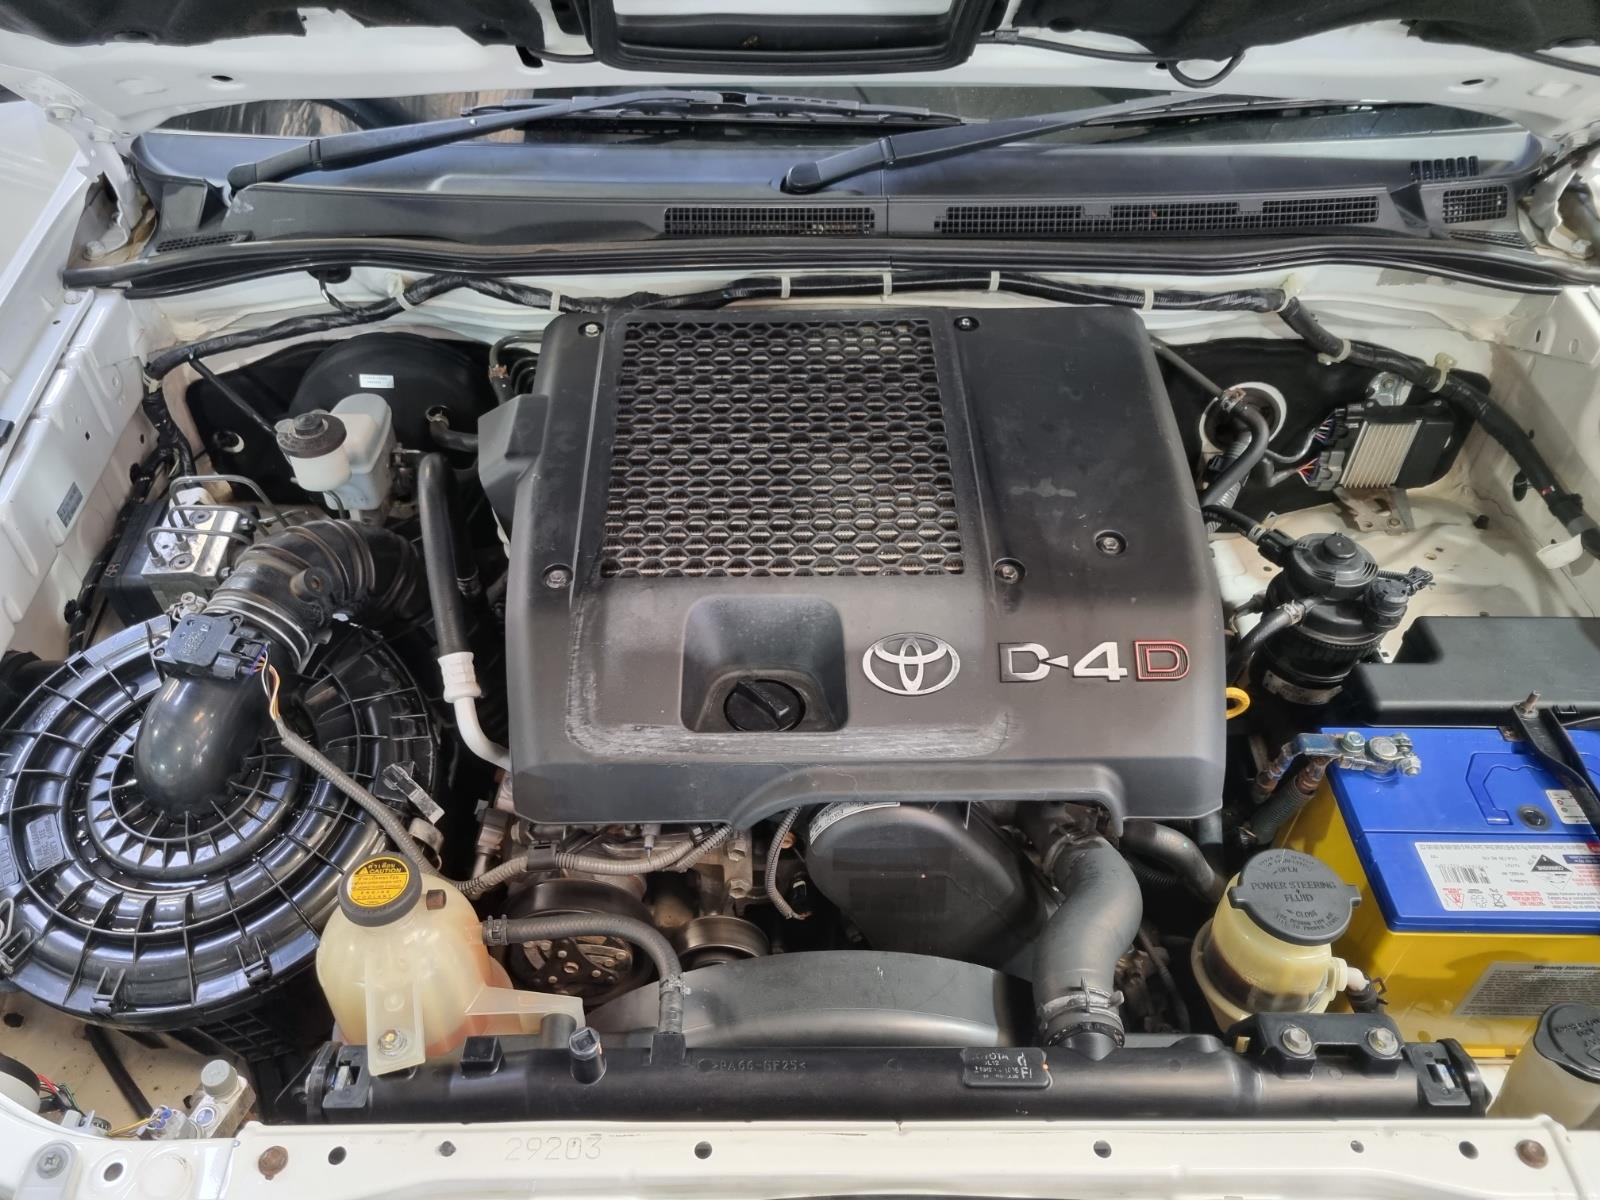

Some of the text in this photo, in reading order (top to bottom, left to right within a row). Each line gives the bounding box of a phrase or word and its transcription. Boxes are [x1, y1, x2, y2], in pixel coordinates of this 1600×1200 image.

[1250, 881, 1337, 890] POWER STEERING
[1284, 894, 1314, 902] FLUID
[505, 1136, 602, 1160] 29203
